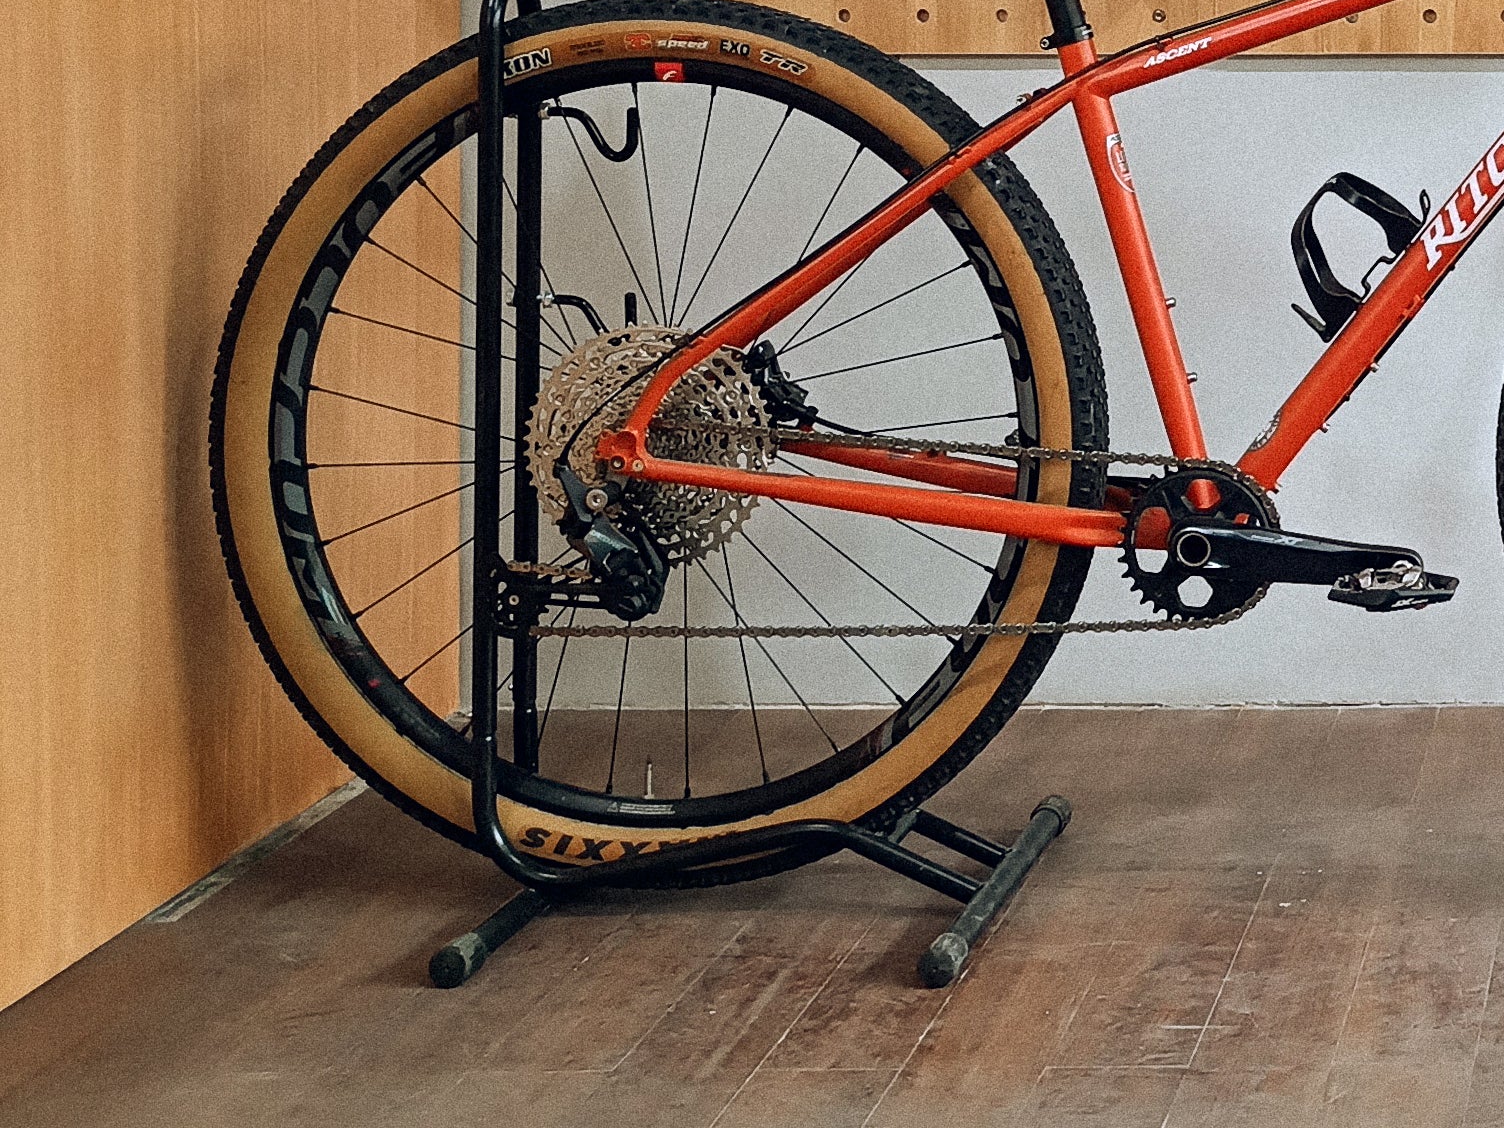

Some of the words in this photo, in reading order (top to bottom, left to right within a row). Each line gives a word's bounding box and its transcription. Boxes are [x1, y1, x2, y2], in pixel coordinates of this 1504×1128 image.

[656, 38, 709, 51] speed
[719, 39, 751, 58] EXO
[1143, 37, 1212, 68] ASCENT
[503, 47, 552, 80] KON
[759, 49, 808, 76] TR
